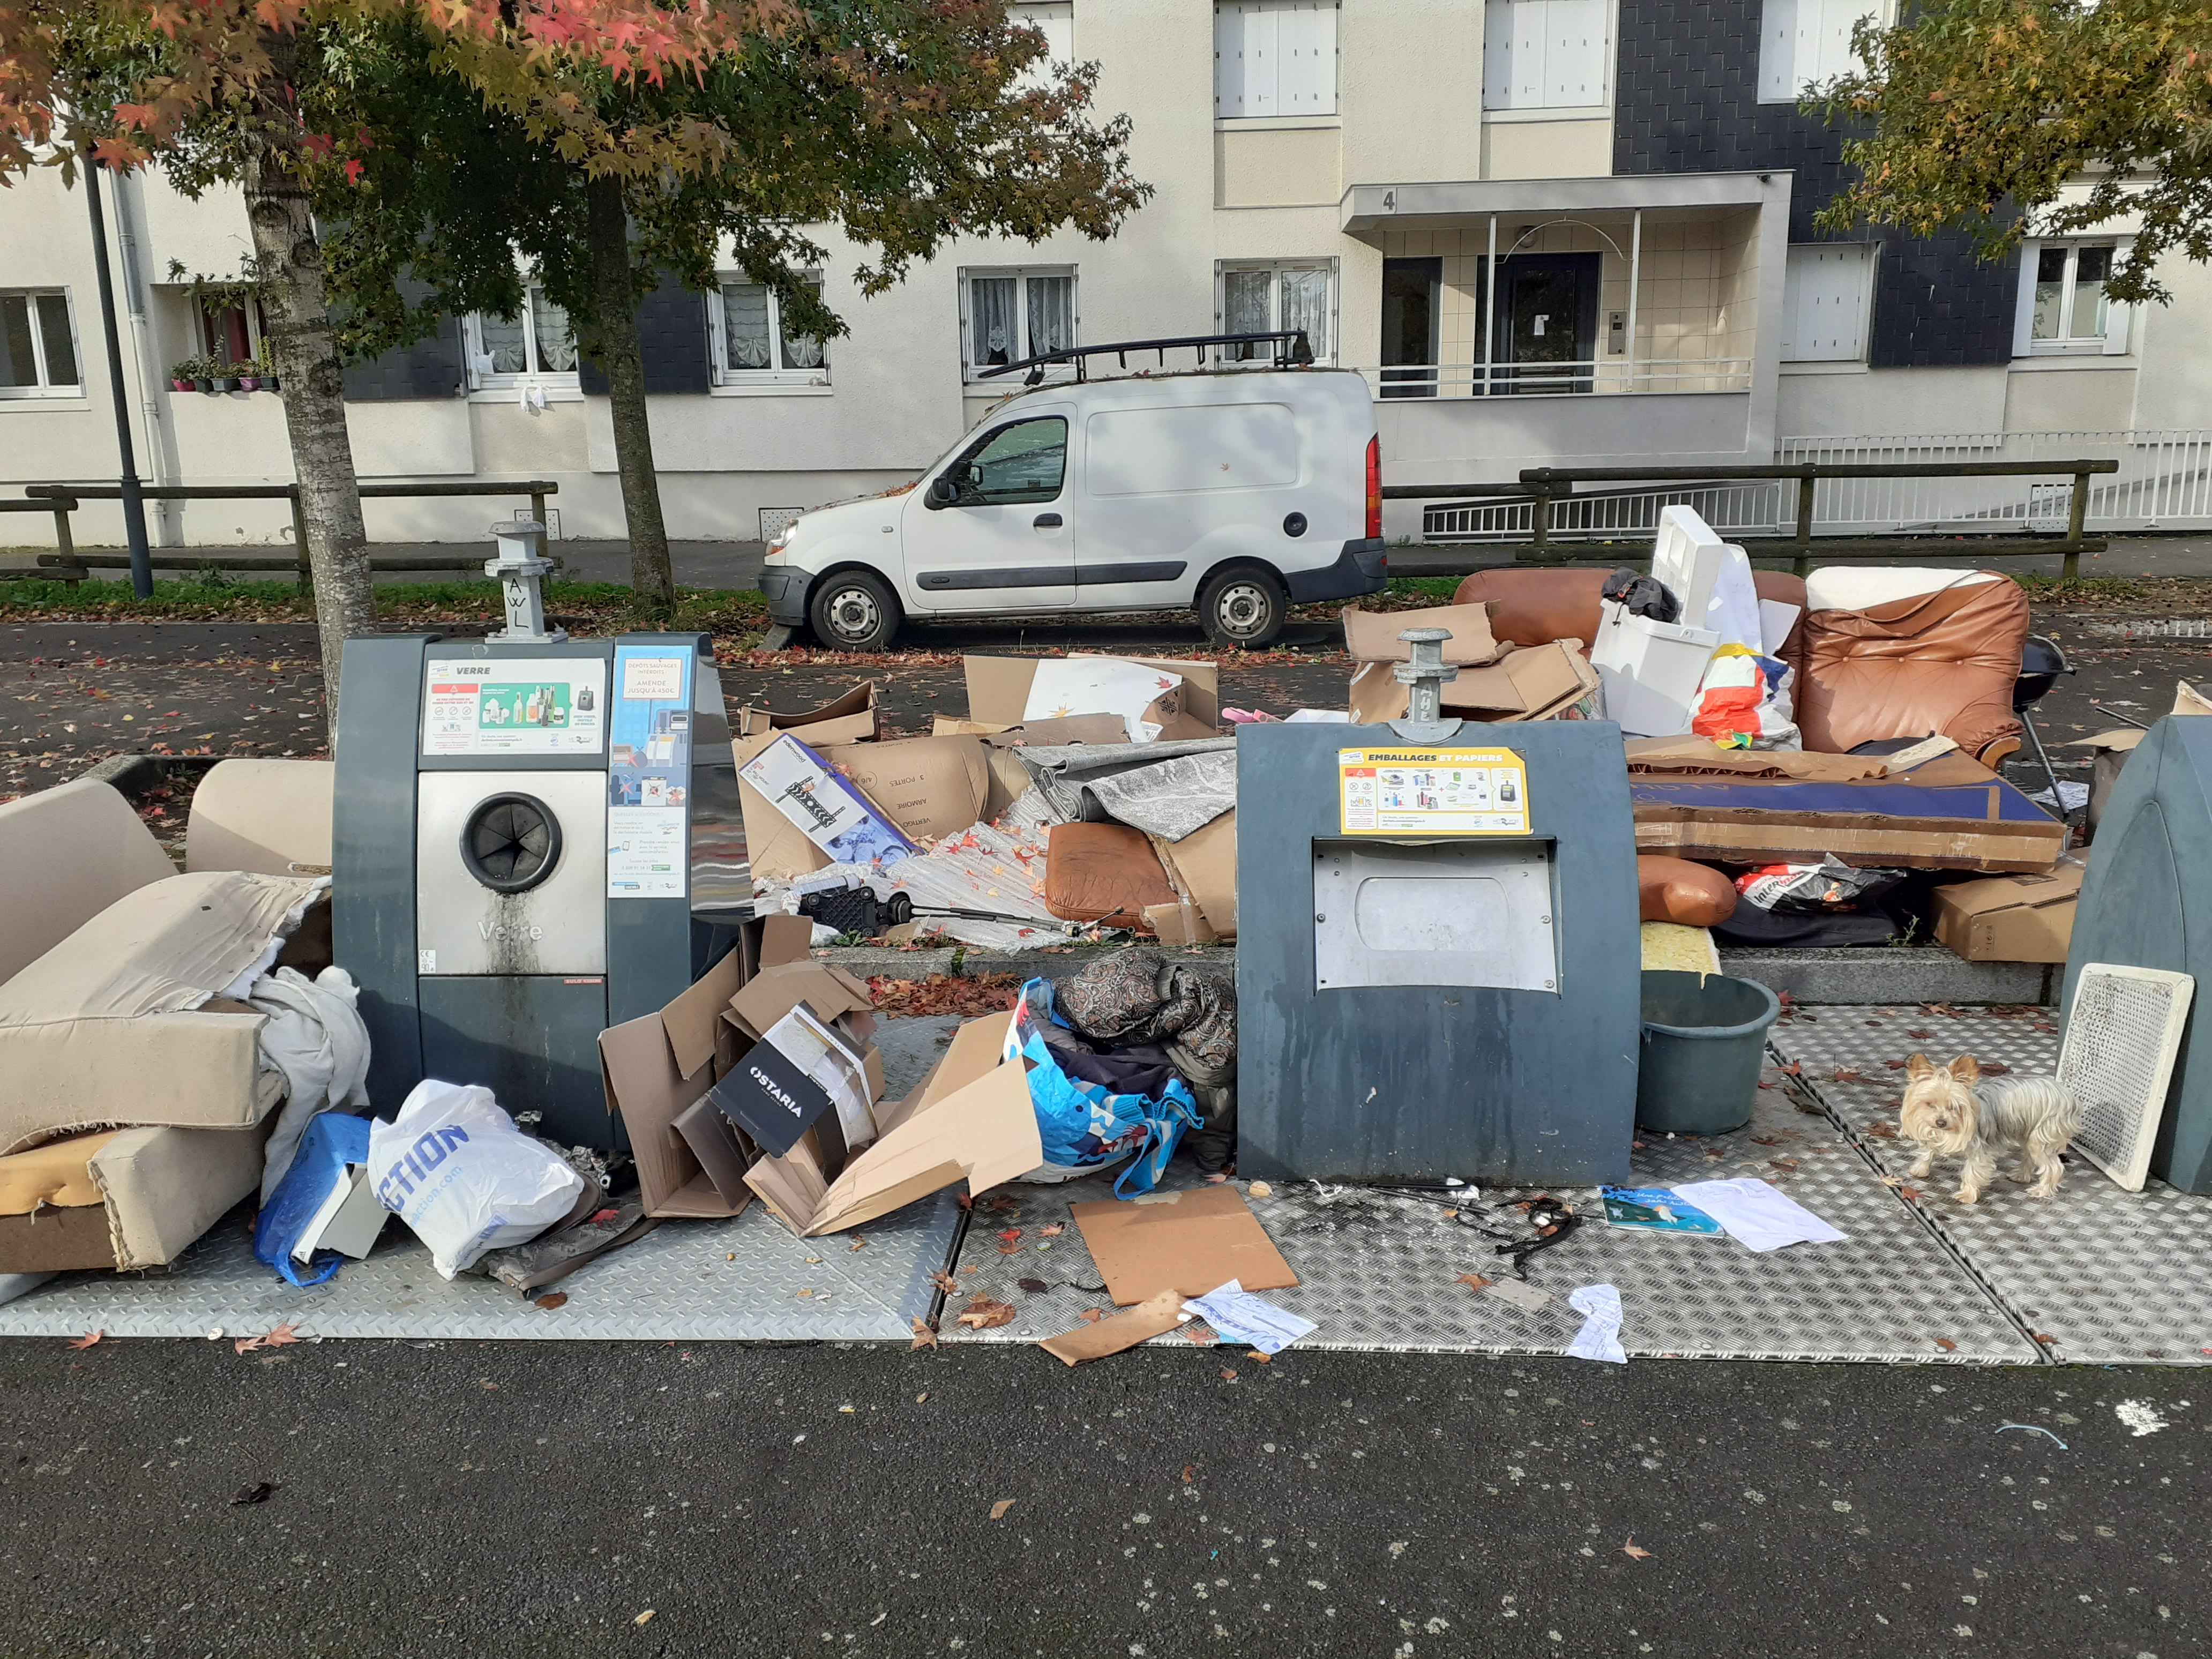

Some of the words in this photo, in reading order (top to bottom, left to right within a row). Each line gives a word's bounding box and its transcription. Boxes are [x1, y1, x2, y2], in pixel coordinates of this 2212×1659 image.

[1383, 191, 1395, 210] 4
[456, 667, 491, 675] VERRE
[783, 739, 806, 764] edenwood
[889, 776, 916, 787] PORTES
[896, 798, 927, 810] ARMOIRE
[902, 817, 931, 828] VERTIGO
[477, 921, 543, 940] Verre
[750, 1067, 803, 1118] OSTARIA
